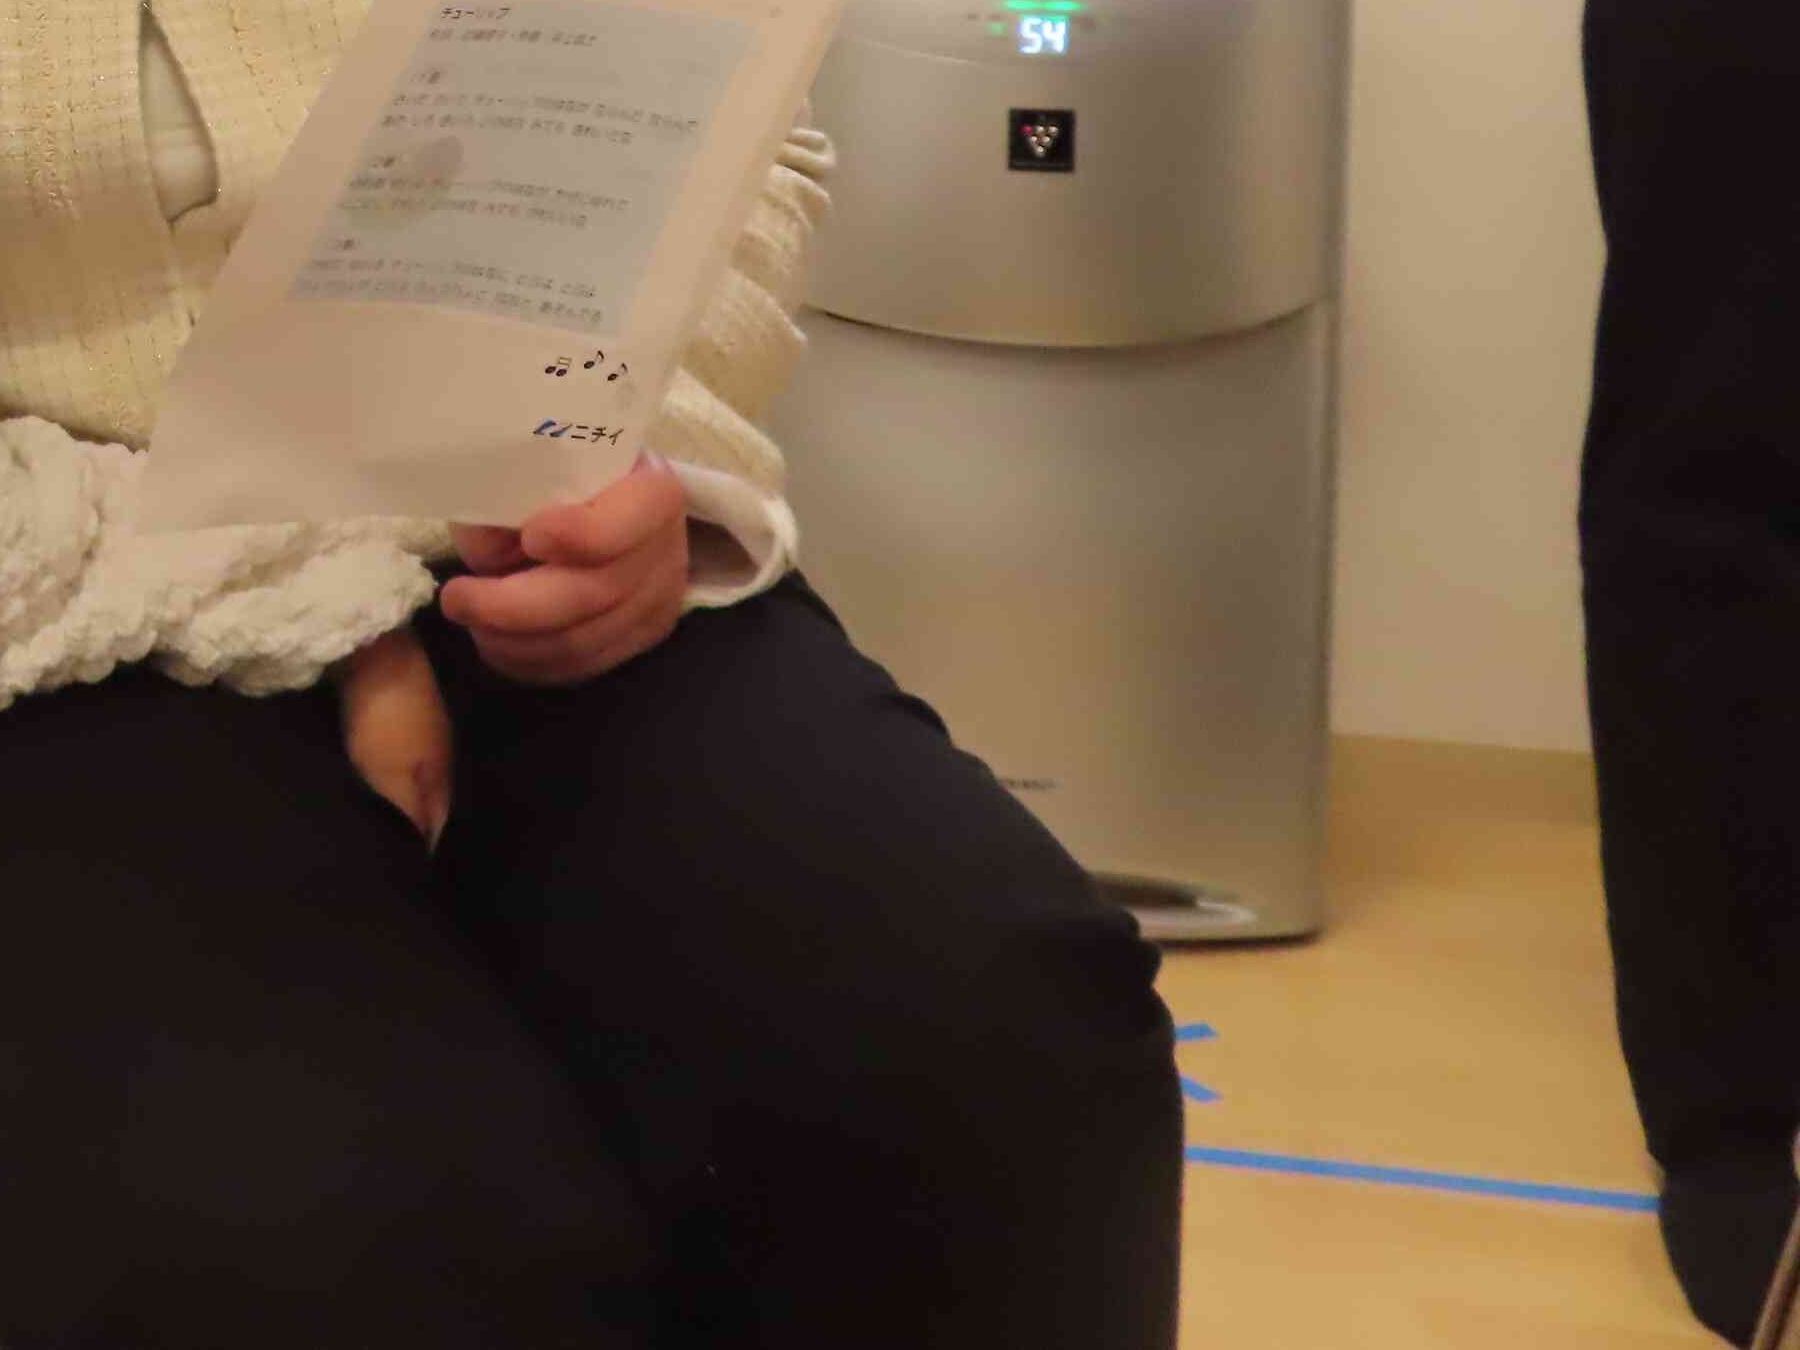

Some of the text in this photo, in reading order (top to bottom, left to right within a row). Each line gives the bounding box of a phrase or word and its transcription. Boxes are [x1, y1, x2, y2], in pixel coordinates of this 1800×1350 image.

[1019, 16, 1066, 54] 54
[571, 425, 625, 446] ニチイ
